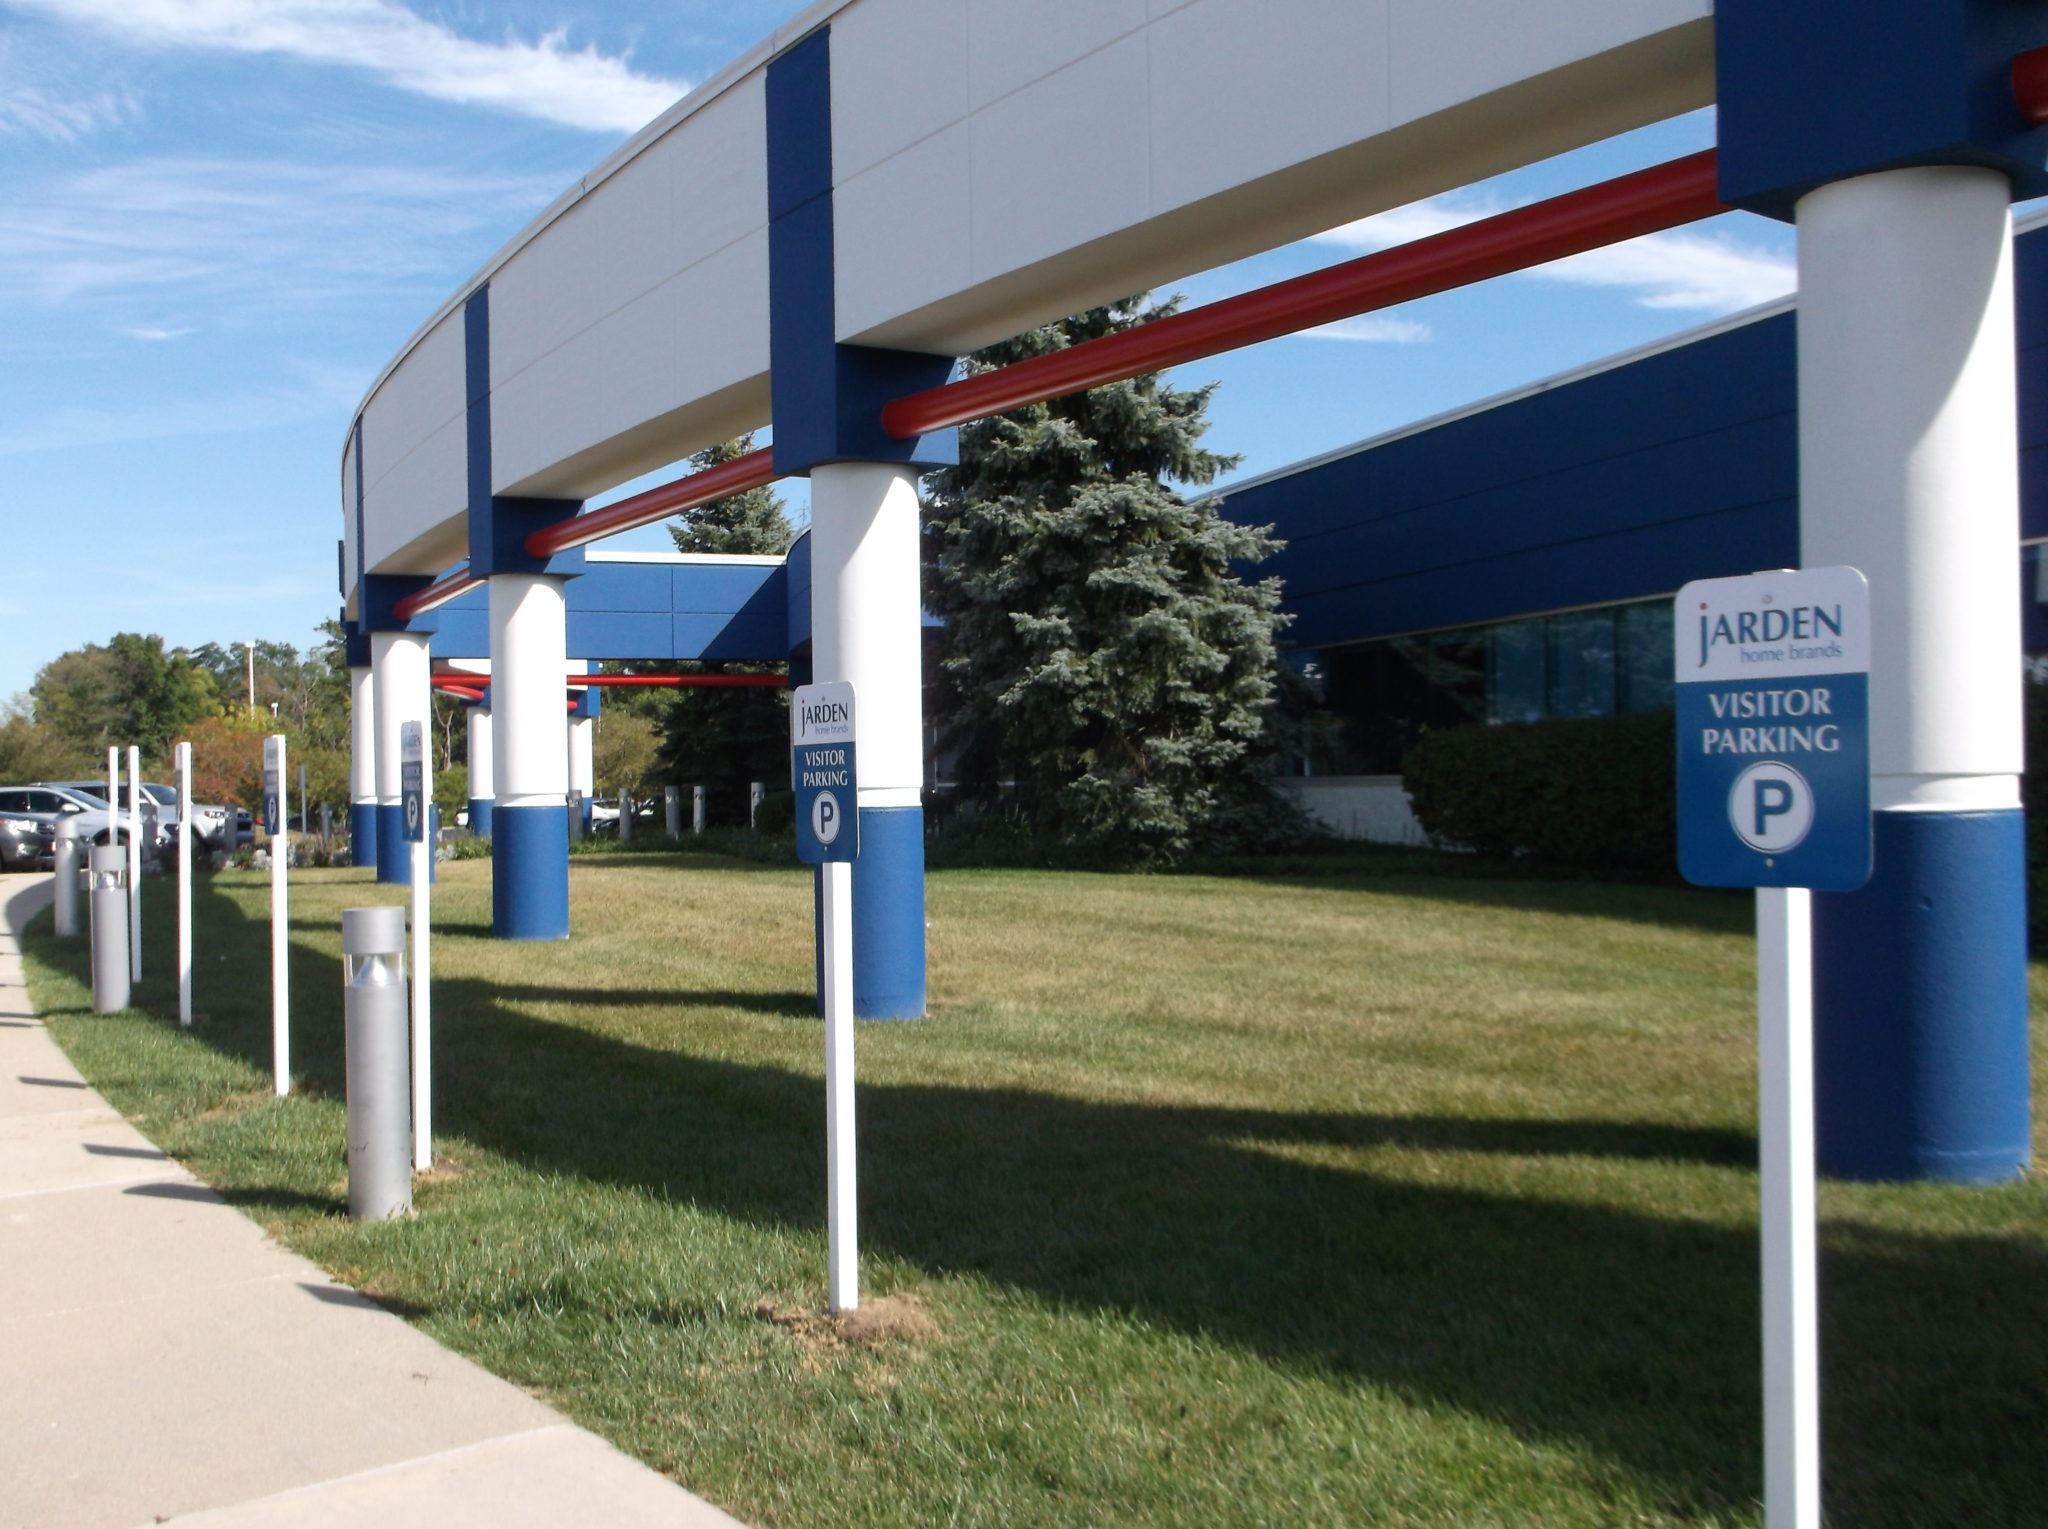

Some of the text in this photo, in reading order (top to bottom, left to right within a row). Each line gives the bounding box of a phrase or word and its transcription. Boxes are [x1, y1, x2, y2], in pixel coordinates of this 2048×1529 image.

[1740, 640, 1842, 663] home brands
[1709, 689, 1832, 719] VISITOR
[1702, 724, 1840, 755] PARKING
[805, 749, 845, 766] VISITOR
[803, 770, 848, 787] PARKING
[821, 801, 833, 834] P
[1754, 779, 1793, 835] P
